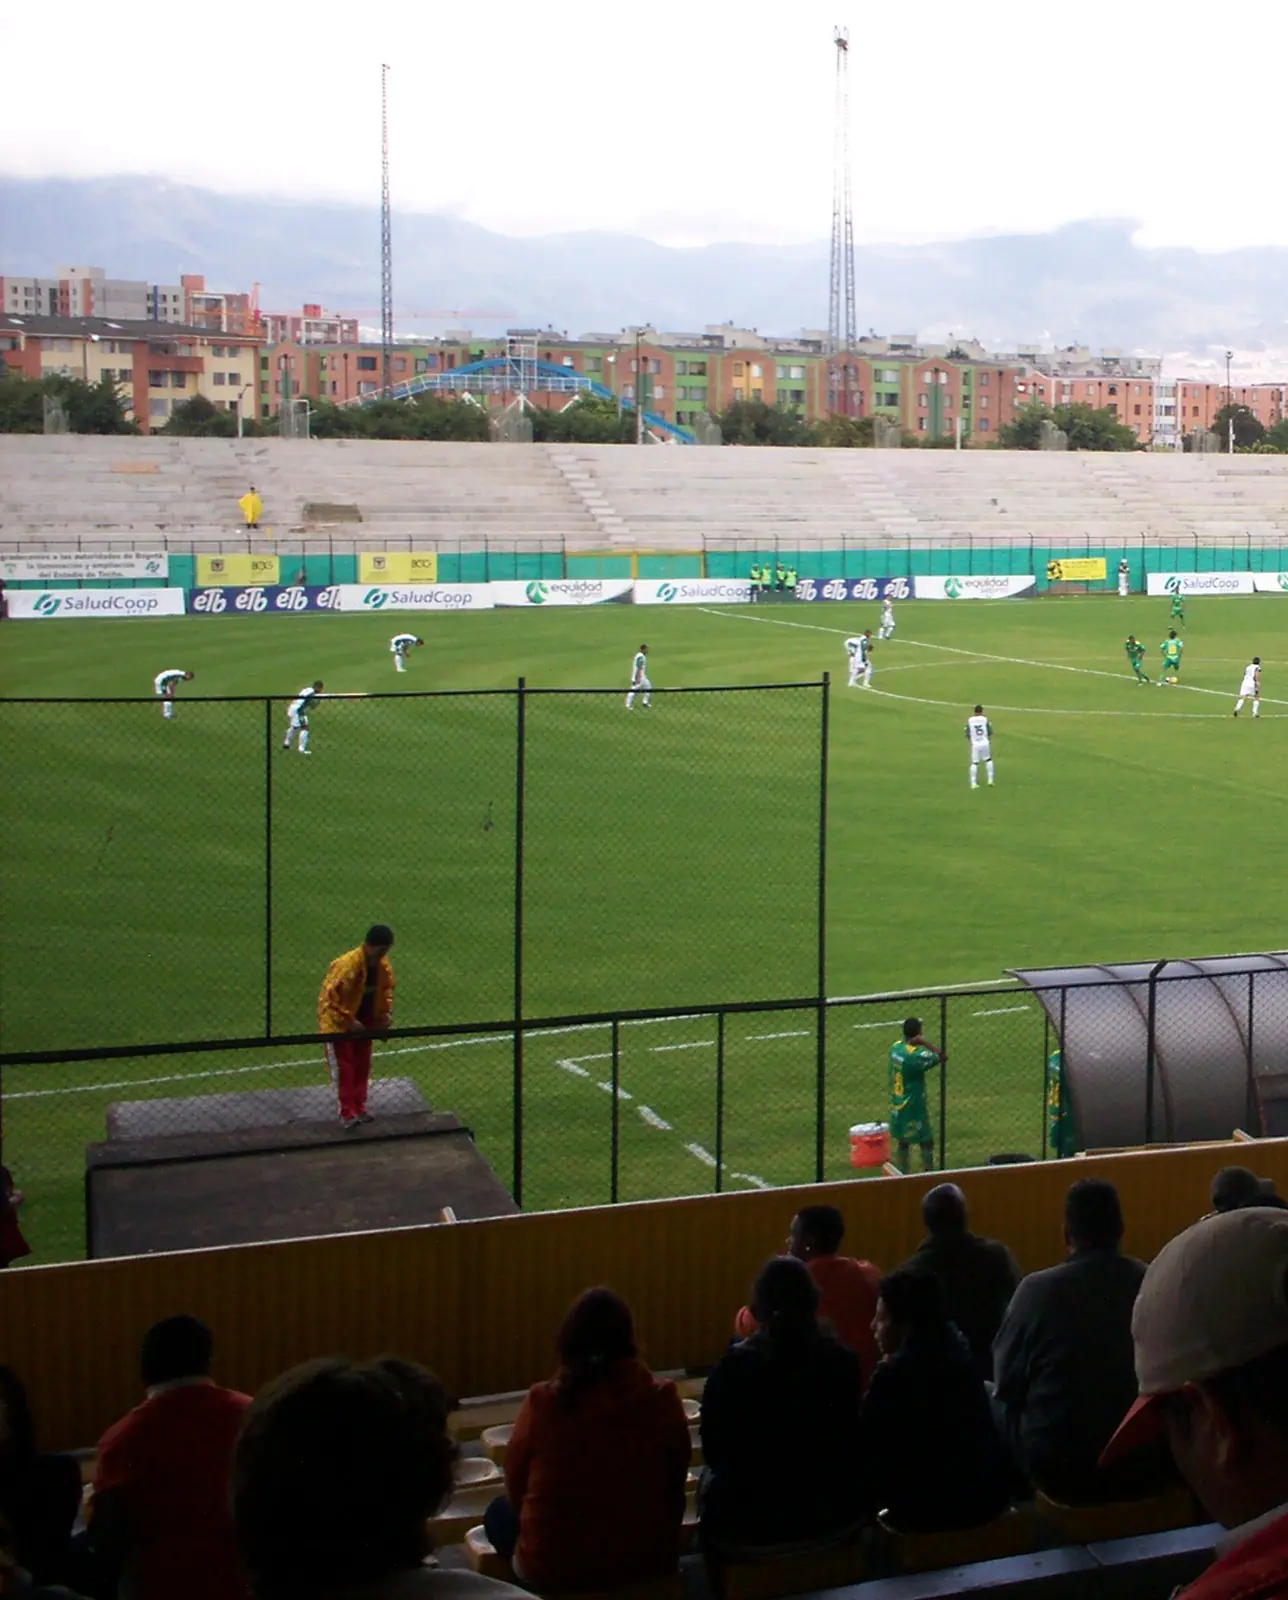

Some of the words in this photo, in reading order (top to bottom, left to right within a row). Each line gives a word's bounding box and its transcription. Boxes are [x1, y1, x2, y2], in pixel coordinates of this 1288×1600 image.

[550, 581, 602, 594] equidad
[965, 577, 1009, 590] equidad
[1183, 577, 1240, 590] SaludCoop
[390, 588, 473, 606] SaludCoop
[680, 584, 752, 600] SaludCoop
[64, 595, 158, 611] SaludCoop
